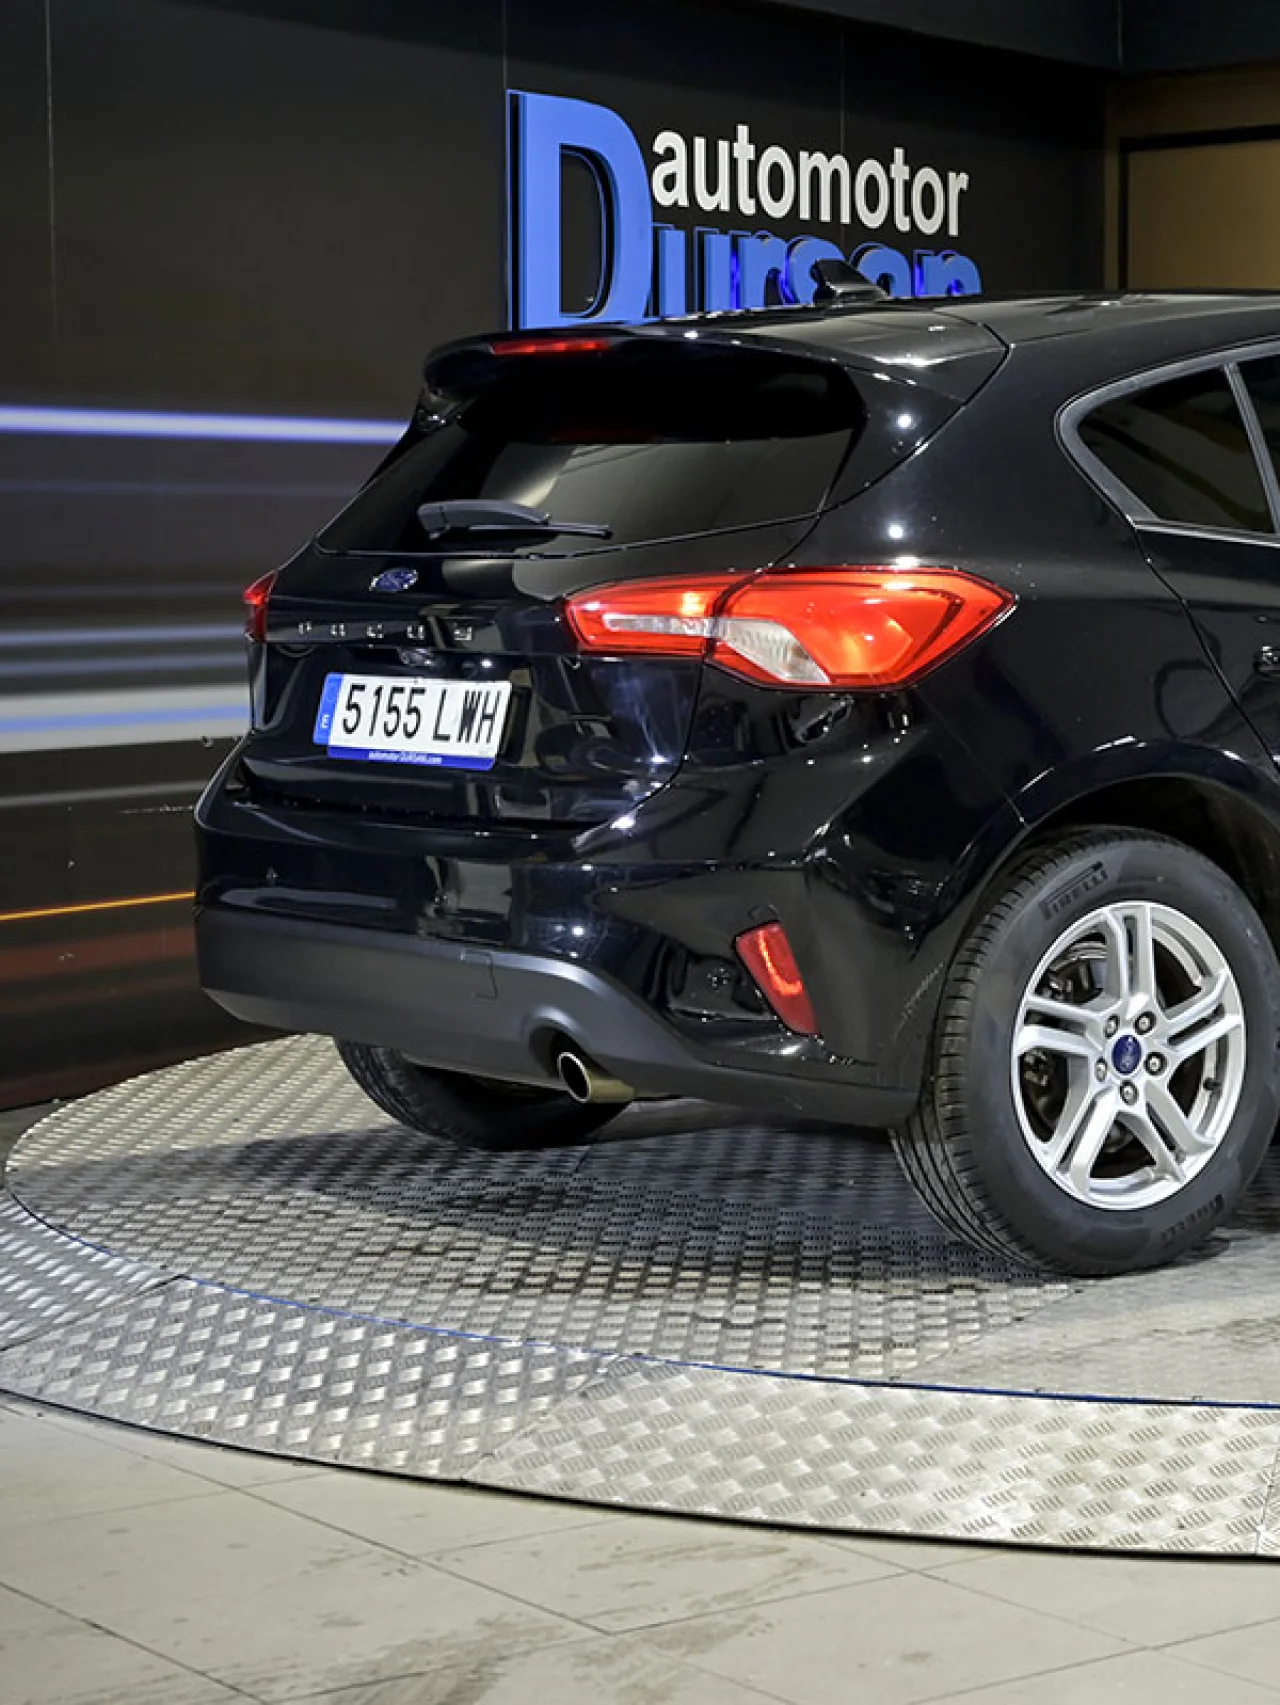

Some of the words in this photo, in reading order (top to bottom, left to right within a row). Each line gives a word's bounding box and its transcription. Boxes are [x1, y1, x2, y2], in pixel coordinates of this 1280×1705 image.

[652, 124, 969, 236] automotor
[342, 684, 426, 739] 5155
[432, 689, 501, 744] LWH
